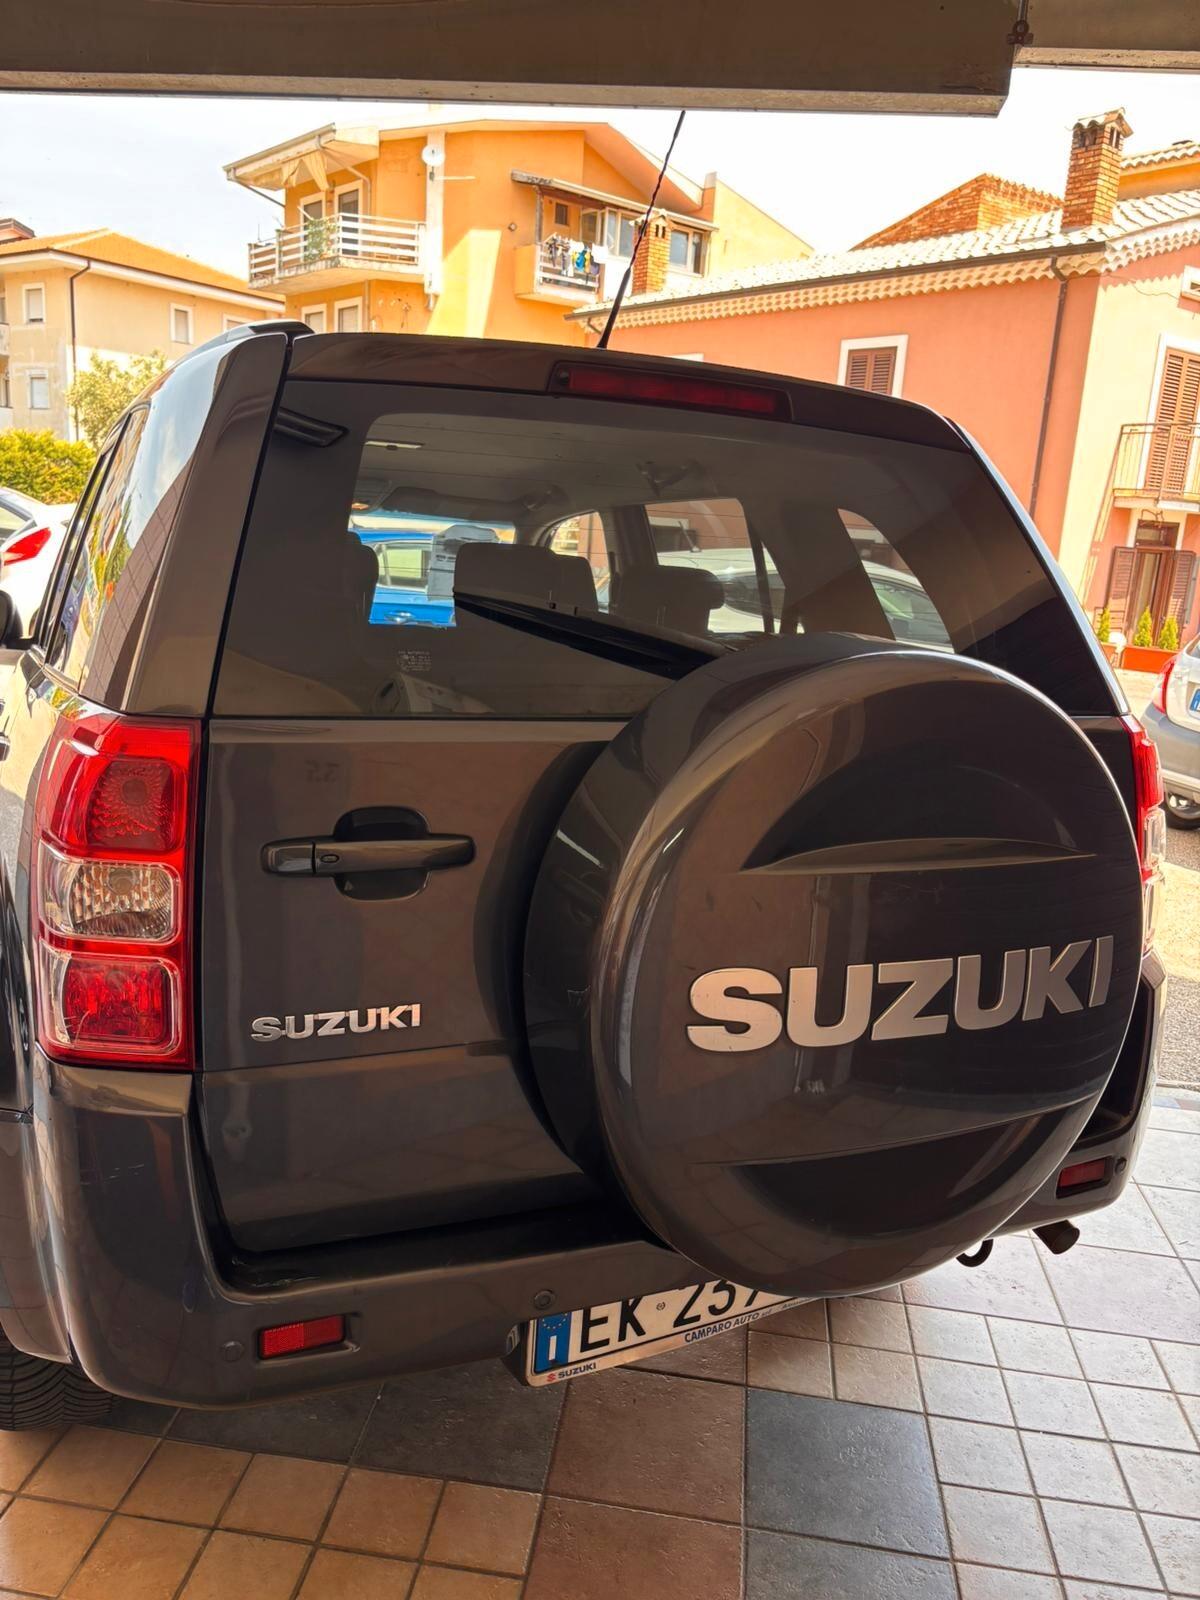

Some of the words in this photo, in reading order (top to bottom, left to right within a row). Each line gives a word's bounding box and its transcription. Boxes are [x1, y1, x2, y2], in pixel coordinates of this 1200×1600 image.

[687, 935, 1114, 1052] SUZUKI
[250, 1003, 421, 1042] SUZUKI
[580, 1297, 646, 1353] EK
[684, 1320, 732, 1343] CAMPARO
[732, 1312, 760, 1329] AUTO
[558, 1362, 597, 1378] SUZUKI
